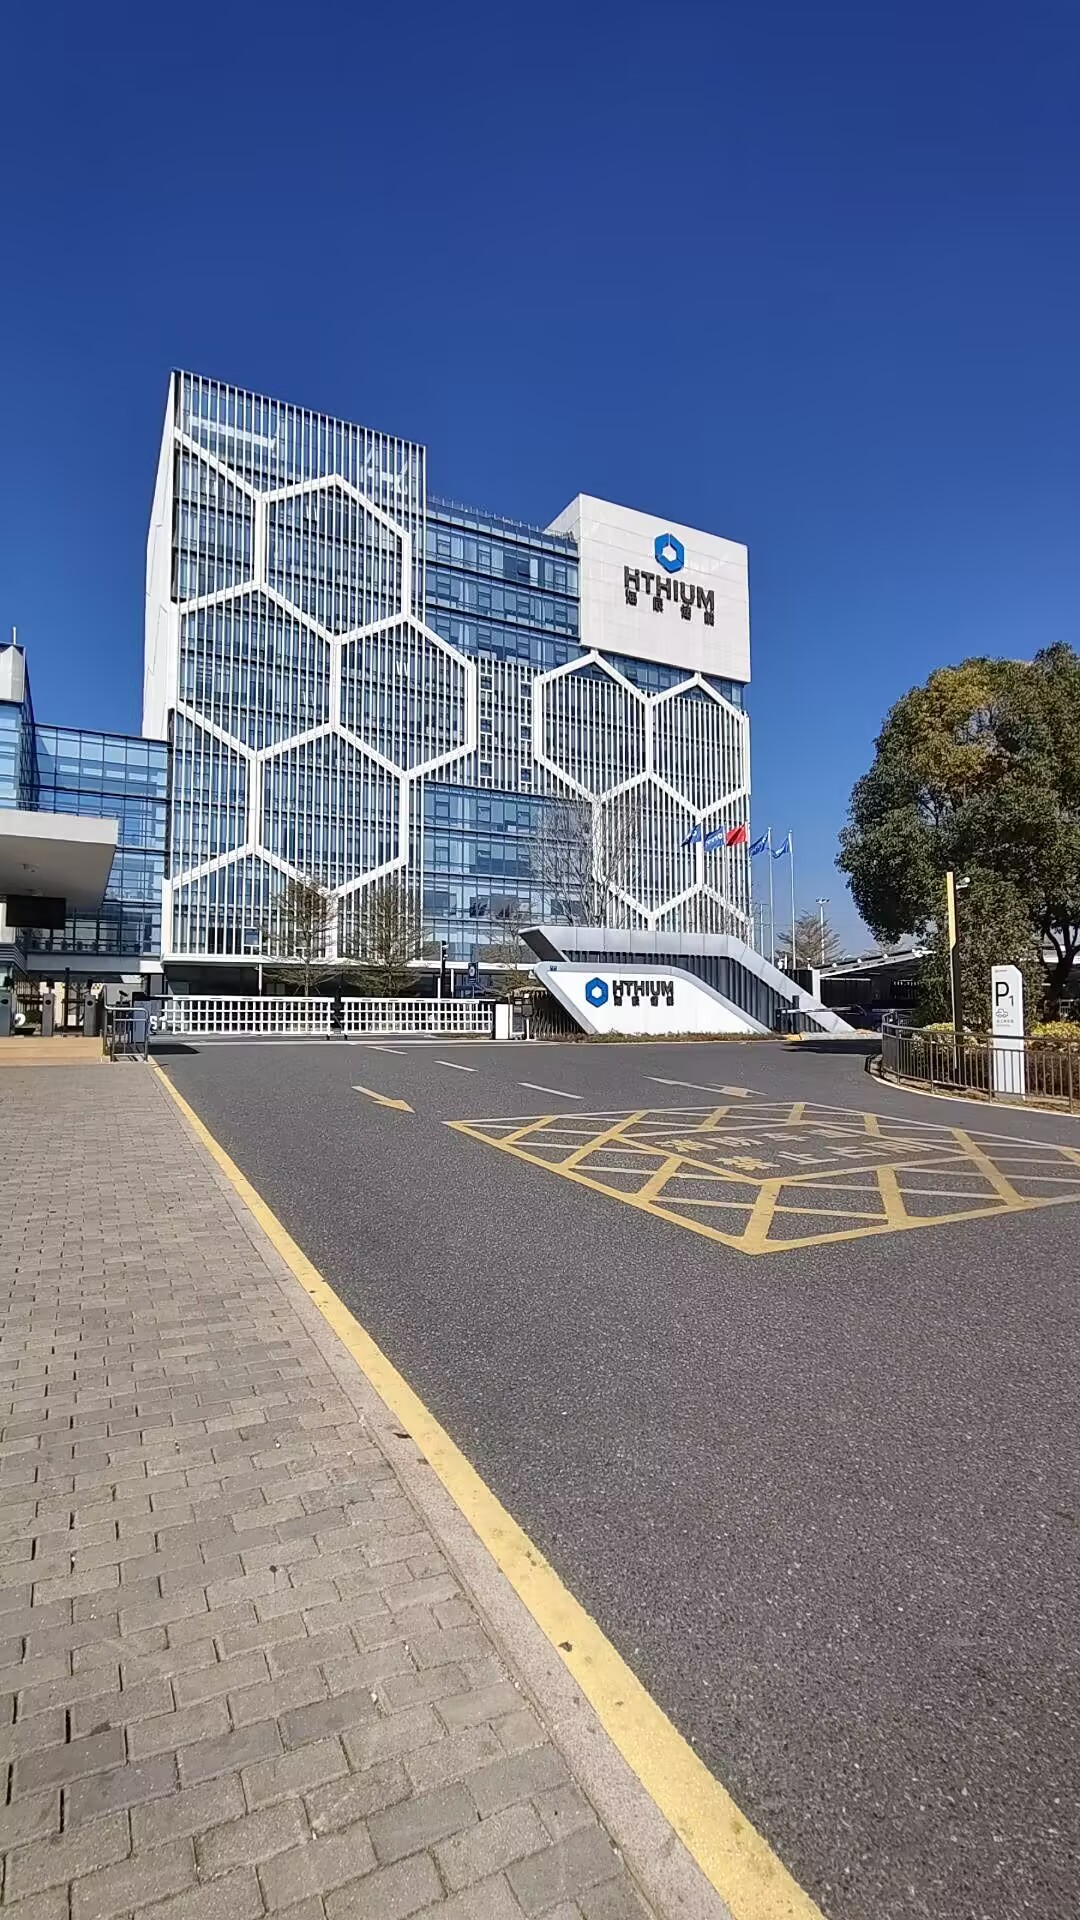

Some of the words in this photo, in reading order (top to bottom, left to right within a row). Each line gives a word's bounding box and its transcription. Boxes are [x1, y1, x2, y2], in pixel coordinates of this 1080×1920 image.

[655, 1129, 860, 1151] 消防车道
[714, 1141, 931, 1170] 禁止占用
